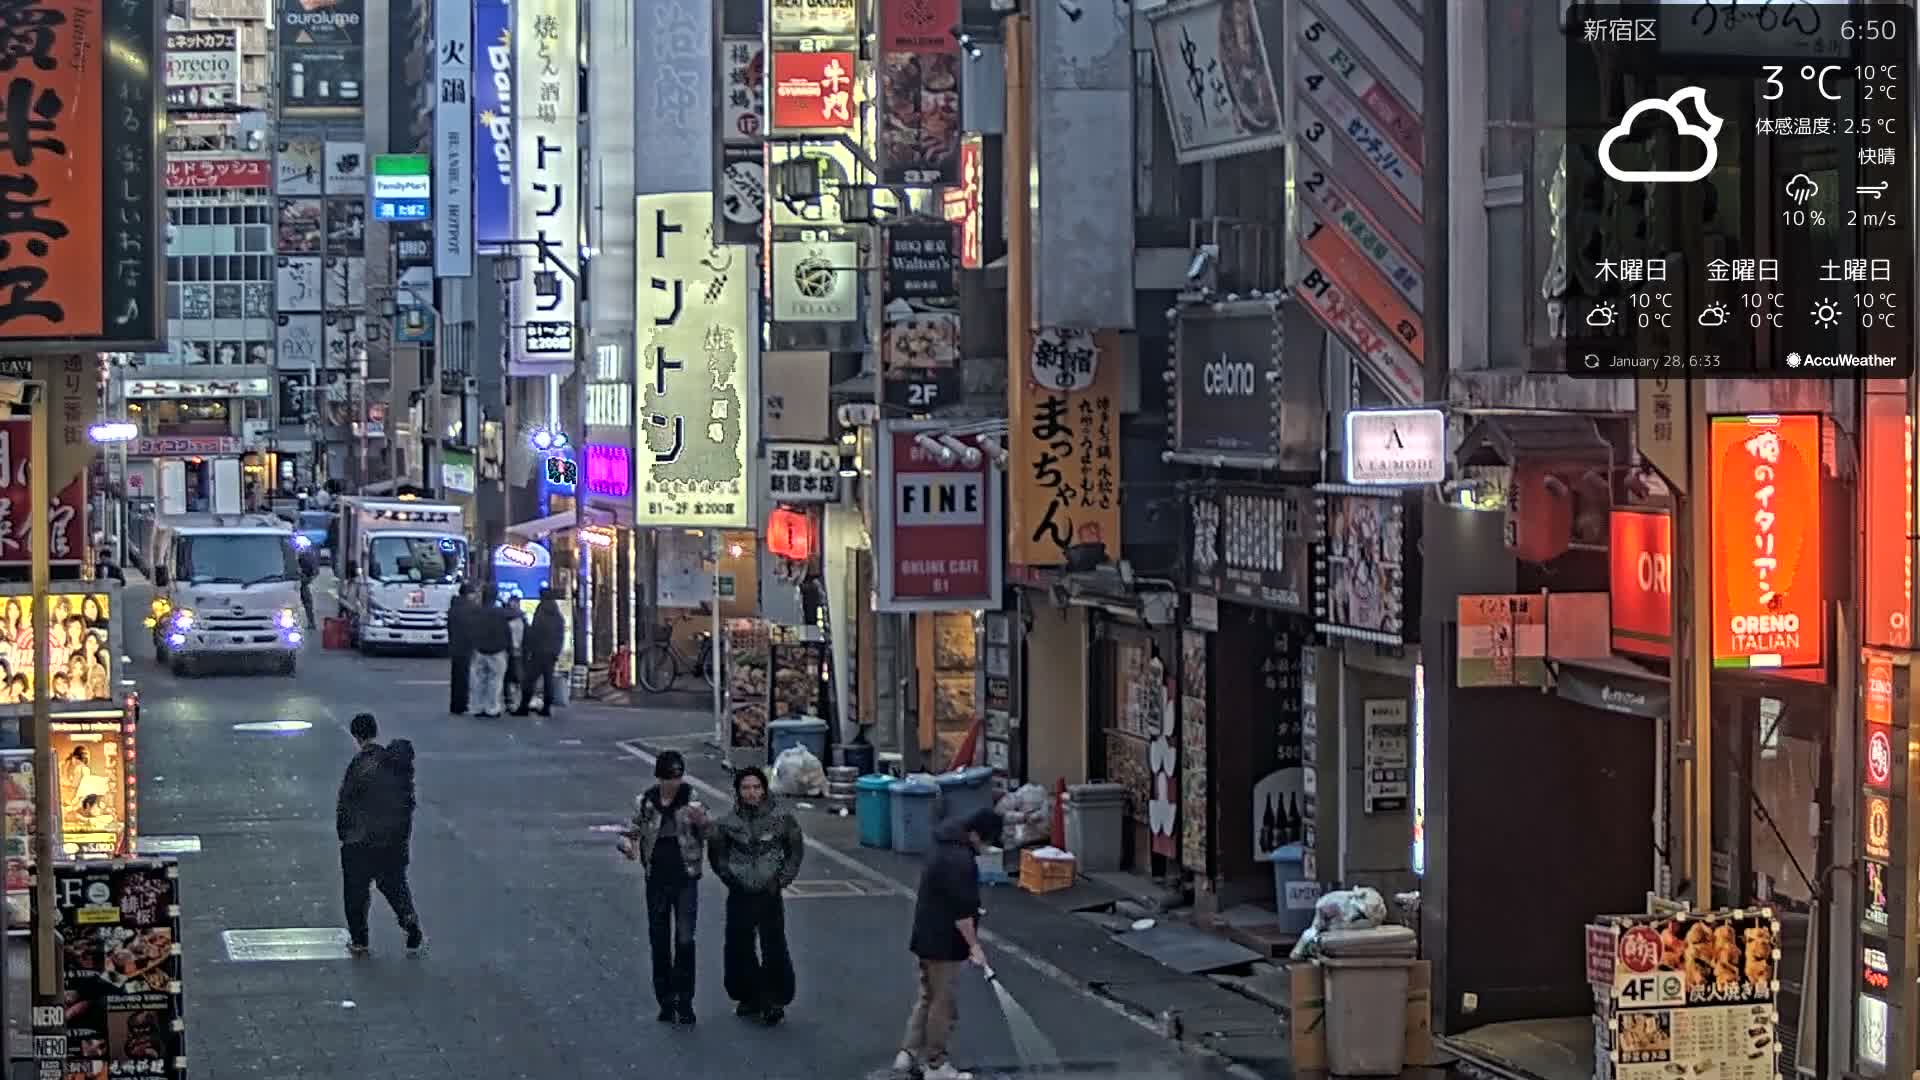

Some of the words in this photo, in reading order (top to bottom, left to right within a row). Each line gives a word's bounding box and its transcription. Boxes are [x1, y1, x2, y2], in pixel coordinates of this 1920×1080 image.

[1305, 22, 1325, 41] 5
[166, 55, 229, 77] precio
[441, 40, 466, 104] 火鍋
[533, 14, 560, 124] 焼とん酒場
[1306, 74, 1325, 91] 4
[1306, 122, 1325, 142] 3
[377, 182, 428, 196] FamilyMart
[1304, 172, 1325, 192] 2
[892, 255, 951, 273] Walton's
[1304, 269, 1330, 297] B1
[650, 209, 683, 462] トントン
[1204, 352, 1255, 394] celona
[908, 384, 939, 405] 2F
[770, 450, 835, 472] 酒場心
[1032, 396, 1077, 549] まっちゃん
[770, 476, 834, 494] 新宿本店
[902, 484, 978, 513] FINE
[1745, 431, 1780, 605] 俺のイタリアン
[901, 559, 945, 575] ONLINE
[950, 559, 980, 574] CAFE
[1731, 615, 1800, 633] ORENO
[1732, 634, 1800, 651] ITALIAN
[1622, 978, 1655, 1001] 4F
[33, 1006, 64, 1027] NERO
[34, 1037, 66, 1057] NERO
